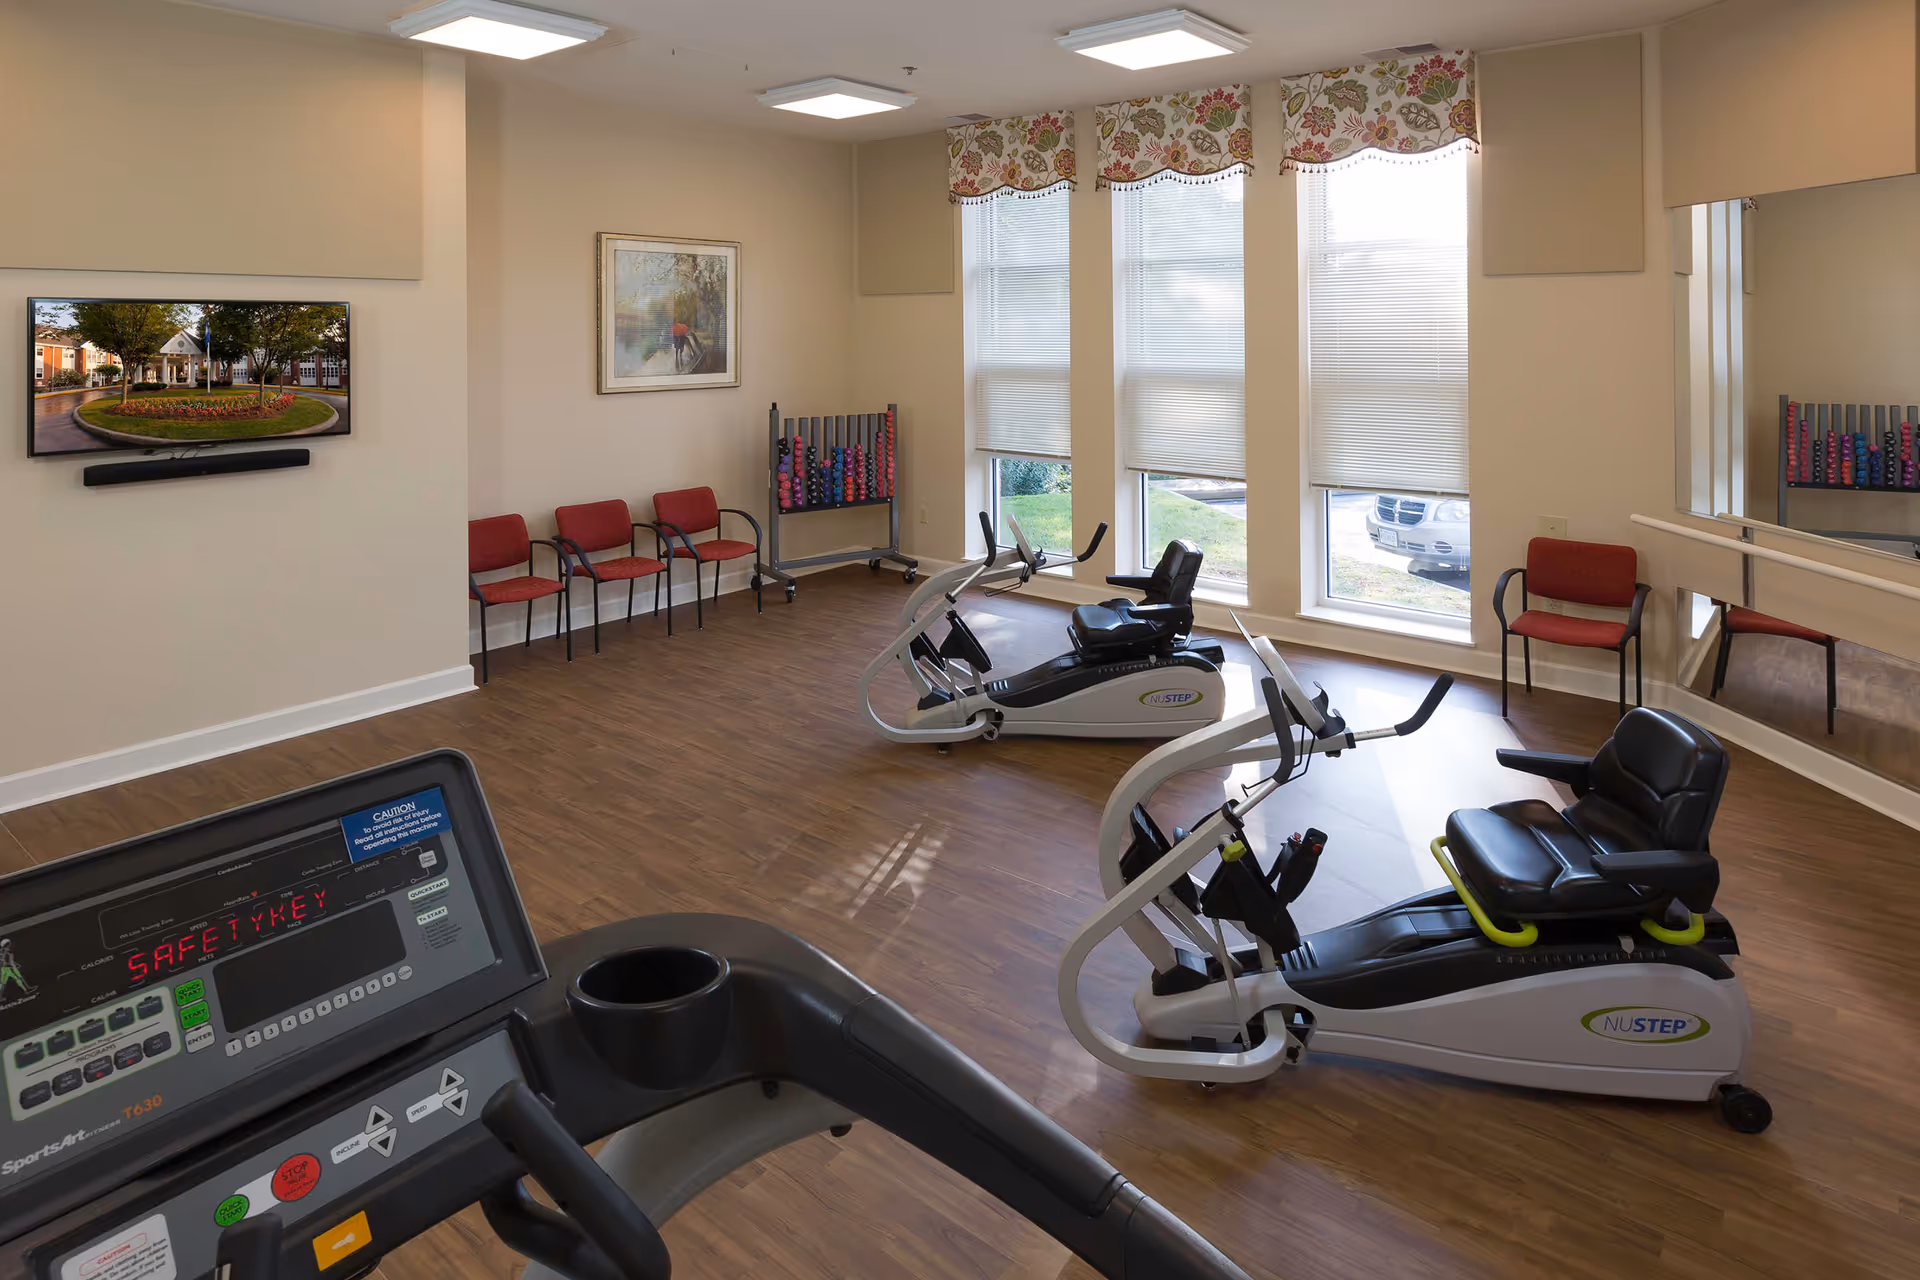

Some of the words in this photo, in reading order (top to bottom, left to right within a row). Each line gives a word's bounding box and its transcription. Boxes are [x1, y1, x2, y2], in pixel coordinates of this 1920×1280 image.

[1150, 693, 1191, 703] NUSTEP
[373, 801, 416, 821] CAUTION
[372, 821, 391, 831] avoid
[393, 816, 405, 825] risk
[412, 808, 429, 818] injury
[355, 834, 373, 845] Read
[375, 831, 383, 839] all
[384, 820, 419, 836] instructions
[420, 812, 441, 823] before
[363, 835, 397, 850] operating
[397, 830, 408, 838] this
[410, 821, 438, 835] machine
[354, 860, 380, 873] DISTANCE
[410, 880, 447, 898] QUICKSTART
[427, 909, 446, 919] START
[189, 921, 208, 931] SPEED
[81, 955, 114, 971] CALORIES
[198, 953, 214, 962] METS
[179, 983, 200, 995] QUICK
[180, 988, 201, 1000] START
[184, 1008, 206, 1020] START
[1603, 1016, 1687, 1034] NUSTEP
[187, 1031, 212, 1045] ENTER
[411, 1104, 427, 1116] SPEED
[1, 1128, 86, 1175] SportsArt
[121, 1093, 162, 1119] T630
[335, 1140, 360, 1156] INCLINE
[281, 1161, 308, 1181] STOP
[219, 1200, 243, 1216] QUICK
[222, 1205, 243, 1221] START
[97, 1244, 131, 1264] CAUTION
